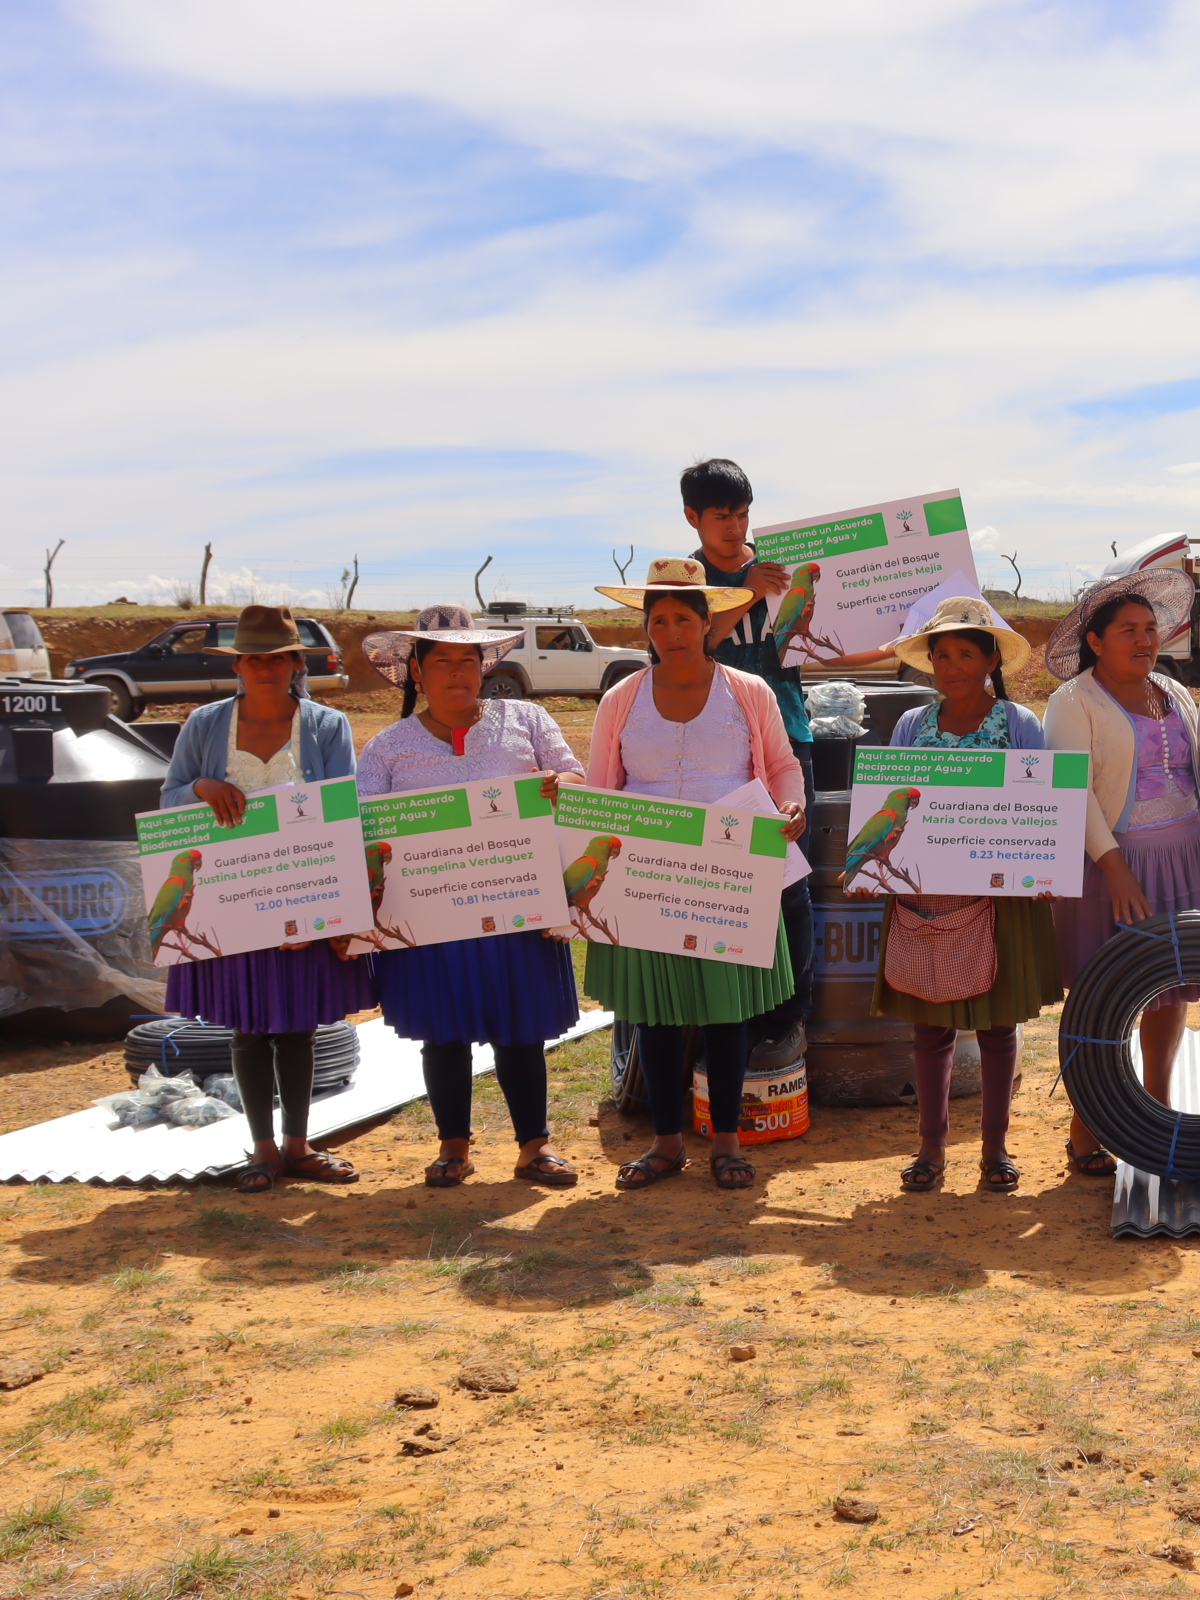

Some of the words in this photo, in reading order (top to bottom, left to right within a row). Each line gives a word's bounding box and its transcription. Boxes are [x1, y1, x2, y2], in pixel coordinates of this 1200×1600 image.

[757, 537, 779, 547] Aquí
[792, 529, 817, 539] firmó
[834, 518, 873, 531] Acuerdo
[759, 543, 806, 557] Recíproco
[807, 539, 823, 549] por
[826, 534, 850, 544] Agua
[836, 563, 882, 577] Guardián
[885, 558, 899, 568] del
[902, 552, 939, 564] Bosque
[842, 578, 870, 589] Fredy
[873, 570, 913, 583] Morales
[915, 563, 942, 575] Mejia
[837, 594, 886, 610] Superficie
[889, 582, 939, 599] conserva
[876, 605, 897, 615] 8.72
[3, 695, 47, 713] 1200
[52, 695, 61, 712] L
[858, 752, 882, 761] Aquí
[900, 753, 928, 761] firmó
[947, 754, 993, 762] Acuerdo
[857, 763, 910, 772] Recíproco
[935, 765, 963, 774] Agua
[857, 773, 929, 782] Biodiversidad
[361, 803, 390, 814] firmó
[410, 794, 454, 807] Acuerdo
[559, 803, 611, 818] Recíproco
[635, 815, 662, 825] Agua
[560, 791, 585, 804] Aquí
[601, 797, 628, 808] firmó
[648, 805, 693, 818] Acuerdo
[930, 802, 989, 811] Guardiana
[993, 803, 1010, 811] del
[1015, 803, 1058, 814] Bosque
[139, 817, 162, 830] Aquí
[164, 817, 175, 826] se
[177, 812, 204, 823] firmó
[378, 815, 396, 826] por
[400, 811, 427, 821] Agua
[430, 810, 436, 818] y
[558, 814, 630, 833] Biodiversidad
[923, 815, 955, 824] Maria
[958, 816, 1007, 825] Cordova
[1011, 817, 1057, 827] Vallejos
[140, 826, 191, 841] Recíproco
[193, 823, 210, 833] por
[927, 836, 985, 846] Superficie
[989, 838, 1056, 846] conservada
[141, 833, 210, 852] Biodiversidad
[404, 847, 463, 861] Guardiana
[467, 842, 484, 852] del
[488, 838, 531, 850] Bosque
[215, 852, 270, 867] Guardiana
[273, 847, 289, 857] del
[293, 841, 333, 854] Bosque
[970, 850, 993, 859] 8.23
[997, 851, 1055, 860] hectáreas
[198, 873, 237, 885] Justina
[240, 866, 273, 878] Lopez
[276, 862, 289, 871] de
[292, 855, 336, 868] Vallejos
[401, 861, 466, 877] Evangelina
[469, 852, 534, 867] Verduguez
[628, 853, 686, 869] Guardiana
[690, 862, 707, 872] del
[711, 865, 753, 879] Bosque
[219, 887, 273, 903] Superficie
[276, 875, 338, 893] conservada
[410, 882, 467, 897] Superficie
[471, 872, 537, 889] conservada
[625, 867, 671, 881] Teodora
[676, 875, 720, 889] Vallejos
[724, 882, 752, 893] Farel
[255, 899, 282, 911] 12.00
[286, 891, 340, 906] hectáreas
[452, 895, 478, 906] 10.81
[482, 888, 540, 902] hectáreas
[625, 888, 681, 904] Superficie
[684, 899, 749, 914] conservada
[660, 908, 688, 919] 15.06
[691, 912, 748, 928] hectáreas
